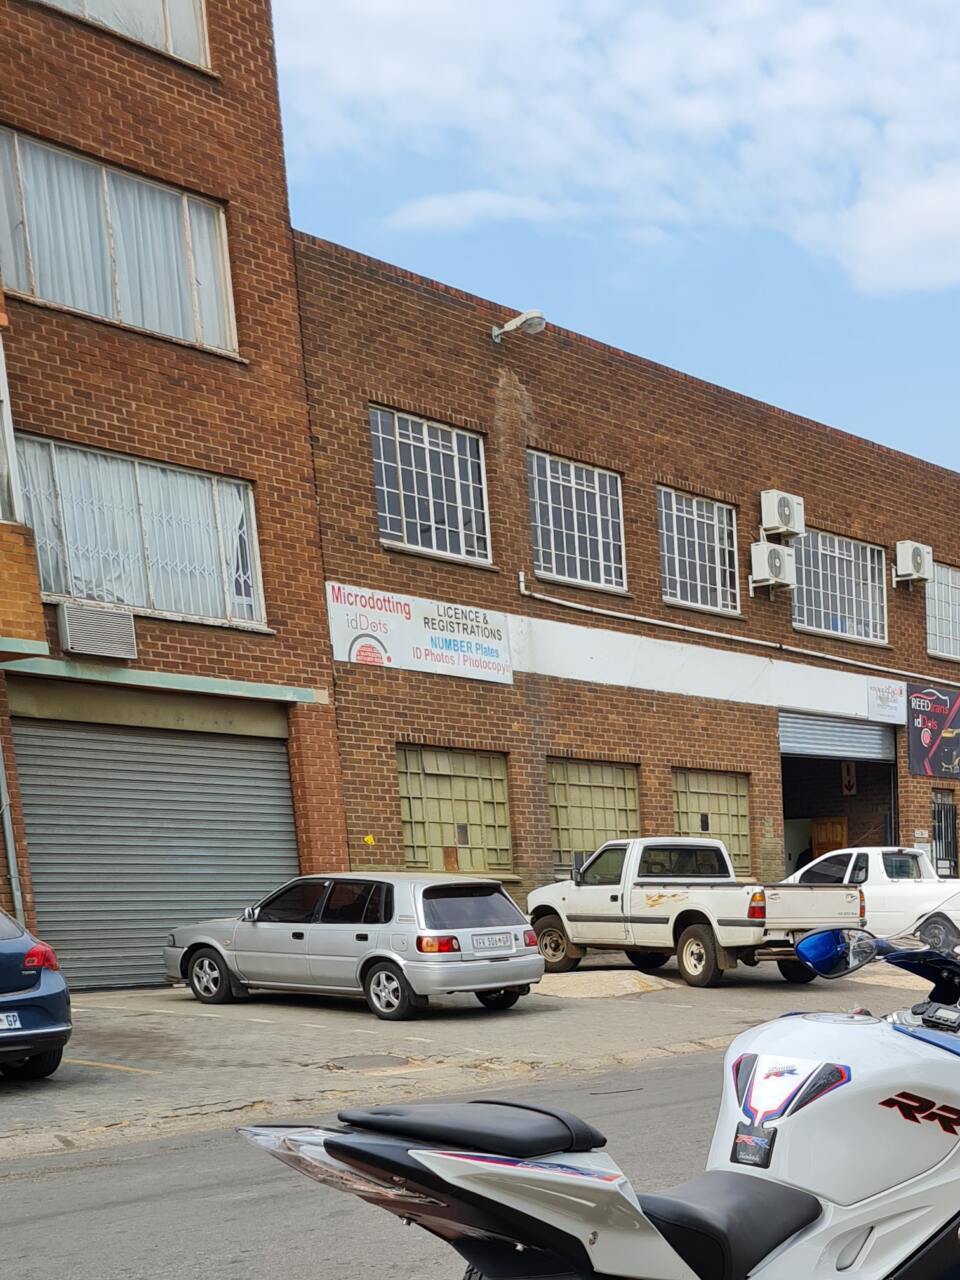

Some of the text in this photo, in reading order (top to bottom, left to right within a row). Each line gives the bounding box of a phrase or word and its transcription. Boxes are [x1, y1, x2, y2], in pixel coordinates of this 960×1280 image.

[331, 585, 411, 620] Microdotting
[346, 613, 389, 634] idDots
[437, 605, 489, 624] LICENCE &
[423, 617, 502, 641] REGISTRATIONS
[412, 646, 422, 660] ID
[424, 648, 455, 665] Photos
[430, 636, 499, 658] NUMBER Plates
[6, 1014, 17, 1026] GP
